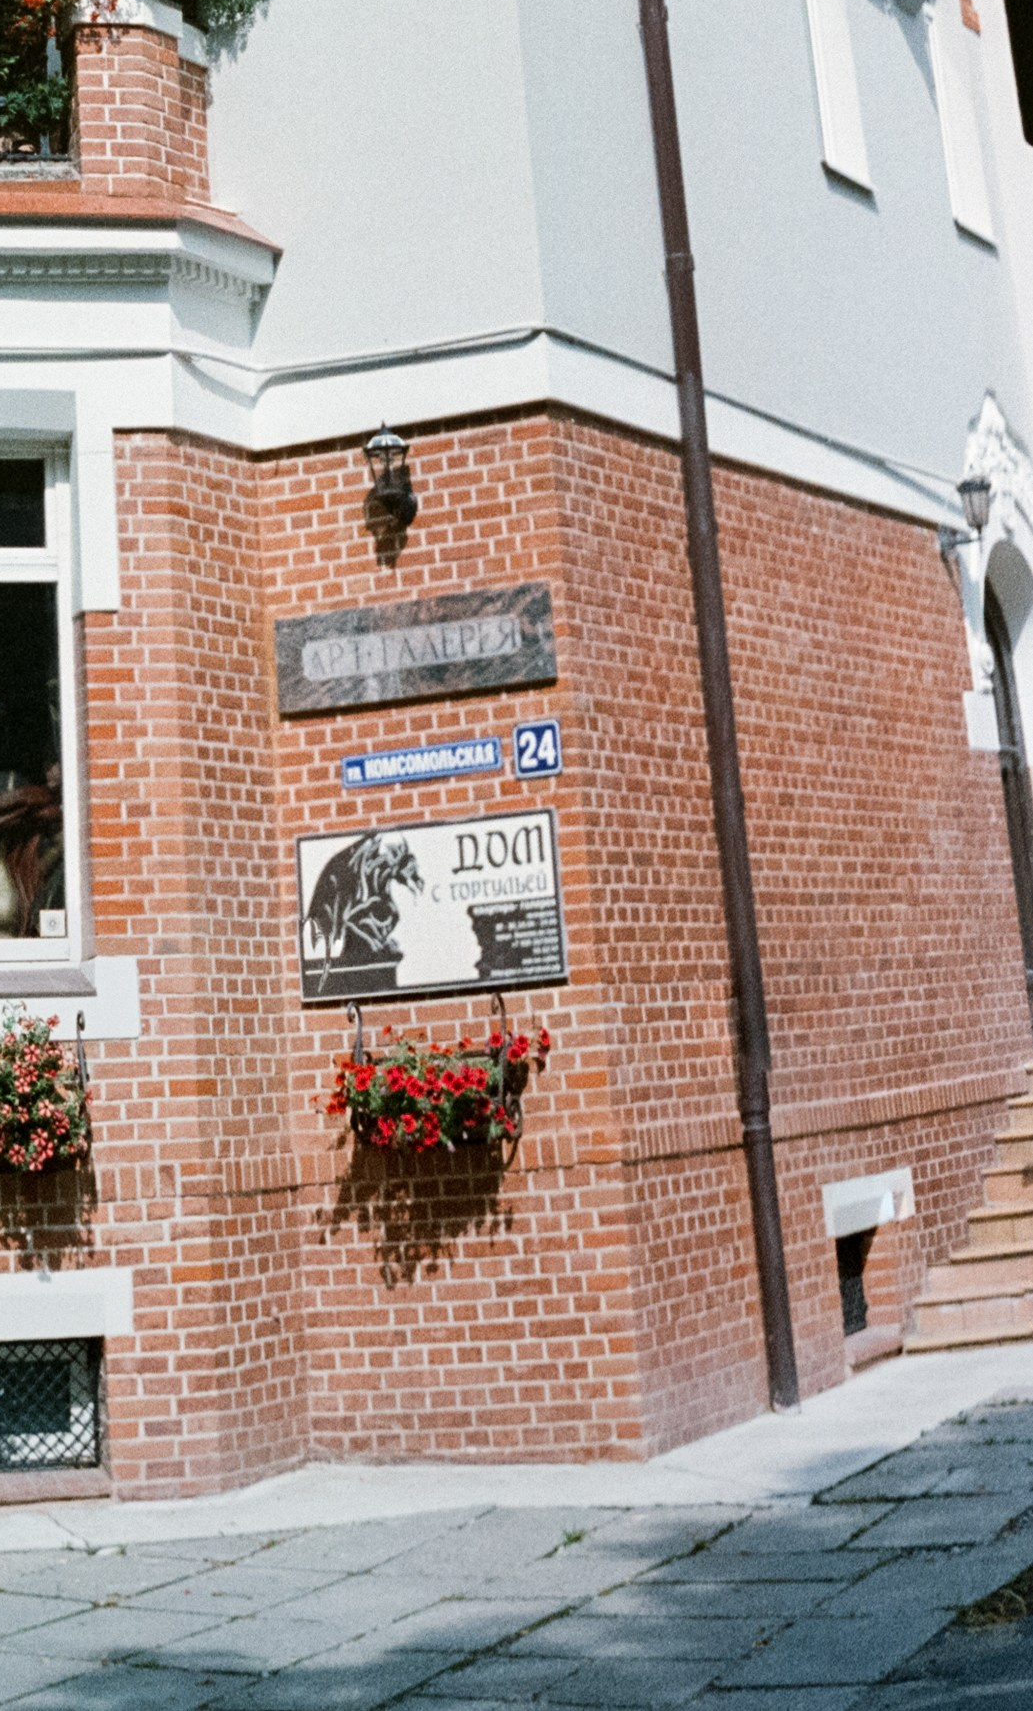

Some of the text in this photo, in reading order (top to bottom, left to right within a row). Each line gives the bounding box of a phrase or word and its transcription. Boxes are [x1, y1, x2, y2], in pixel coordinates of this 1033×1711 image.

[364, 742, 496, 780] КОМСОМОЛЬСКАЯ
[518, 729, 557, 769] 24
[452, 824, 545, 875] ДОМ
